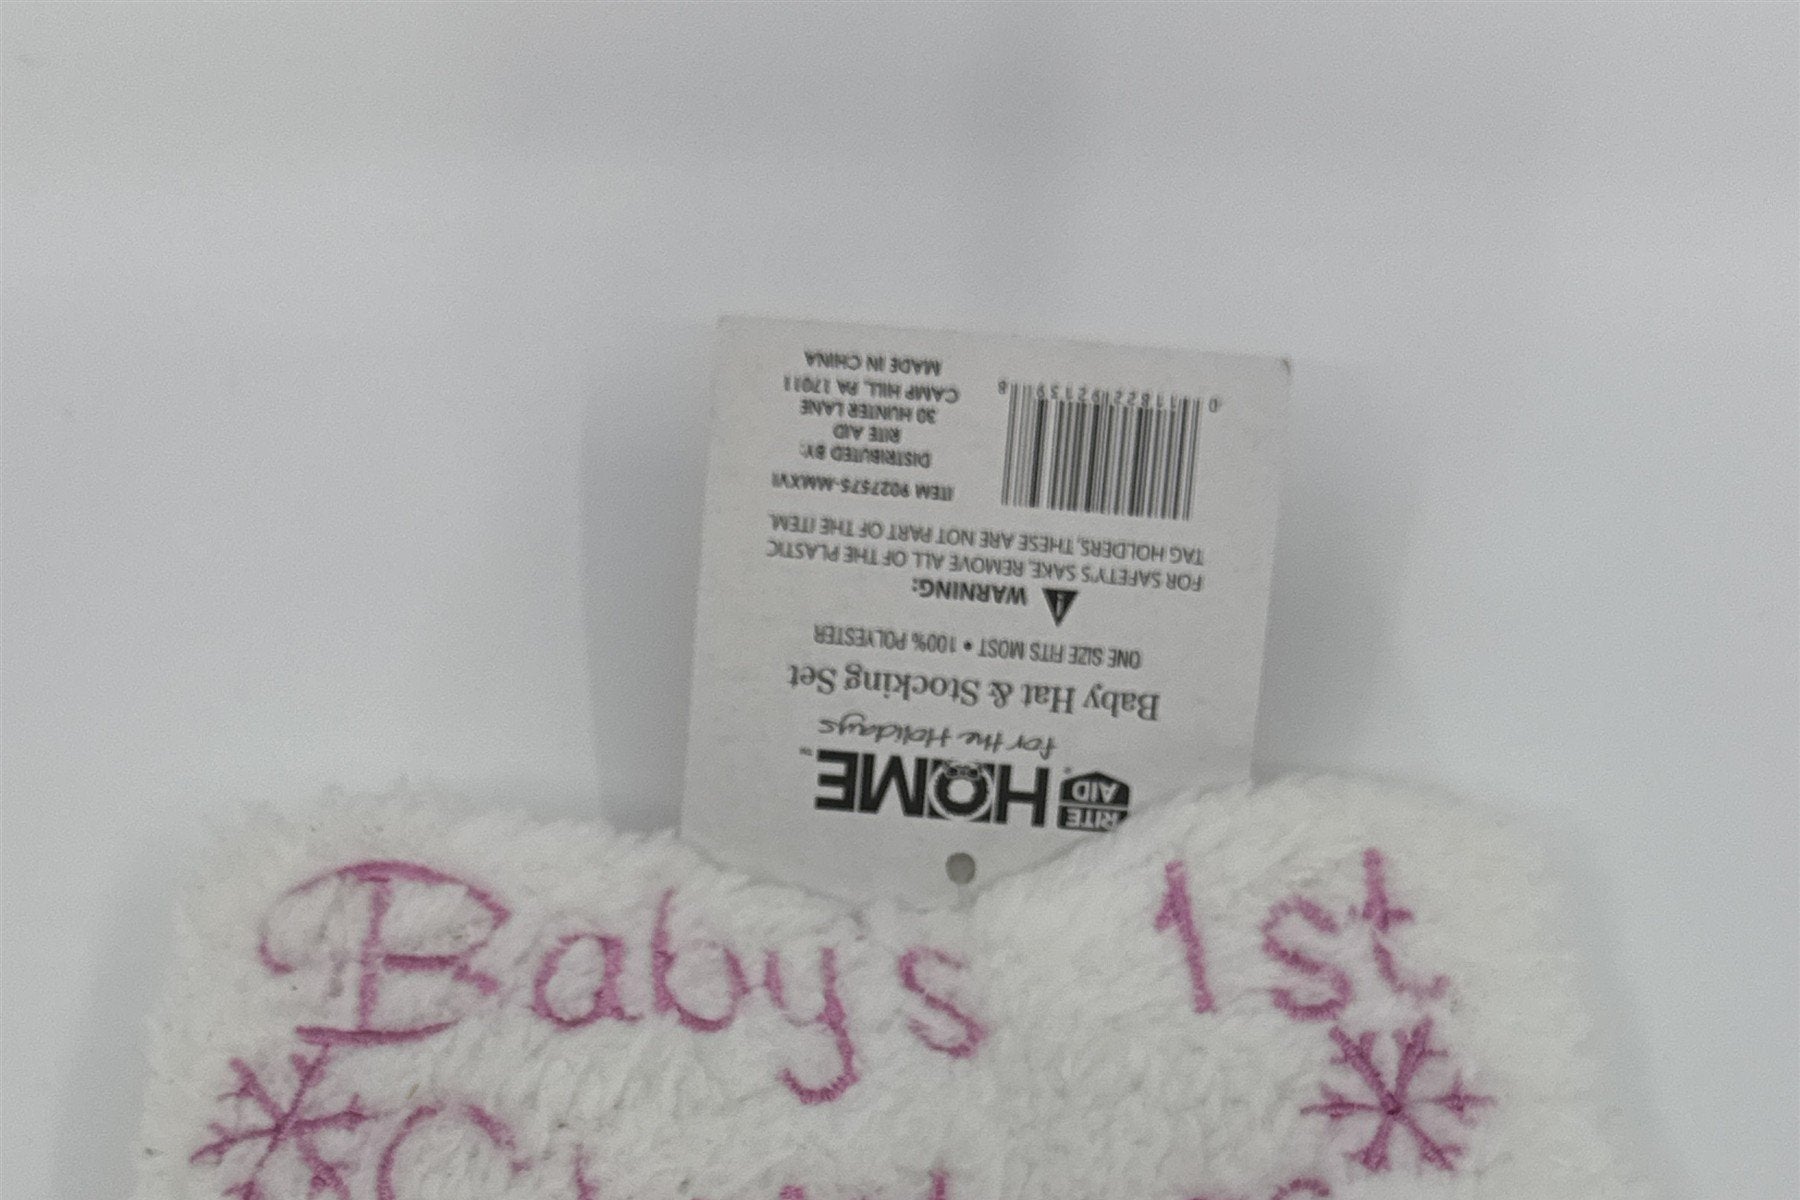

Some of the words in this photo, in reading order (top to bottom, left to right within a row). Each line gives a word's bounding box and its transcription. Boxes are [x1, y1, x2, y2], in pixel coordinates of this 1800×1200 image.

[803, 349, 862, 370] CHINA
[865, 354, 886, 371] IN
[889, 356, 942, 376] MADE
[783, 374, 829, 394] 17011
[836, 379, 858, 396] PA
[904, 384, 960, 404] CAMP
[799, 398, 844, 416] LANE
[847, 401, 912, 422] HUNTER
[916, 406, 936, 424] 30
[832, 423, 863, 439] AID
[870, 426, 900, 443] RITE
[829, 443, 932, 469] DISTRIBUTED
[914, 483, 955, 501] ITEM
[819, 515, 854, 537] THE
[858, 520, 885, 539] OF
[886, 523, 933, 543] PART
[935, 527, 976, 546] NOT
[765, 537, 840, 562] PLASTIC
[979, 530, 1014, 549] ARE
[1018, 532, 1073, 555] THESE
[1076, 536, 1166, 561] HOLDERS,
[843, 545, 878, 565] THE
[881, 549, 908, 568] OF
[911, 550, 944, 569] ALL
[949, 554, 1023, 577] REMOVE
[1169, 545, 1204, 566] TAG
[1081, 565, 1161, 589] SAFETY'S
[1165, 572, 1204, 592] FOR
[911, 577, 1028, 606] WARNING:
[812, 623, 908, 650] POLYESTER
[911, 631, 956, 653] 100%
[977, 637, 1025, 660] MOST
[1029, 641, 1065, 663] FITS
[1067, 644, 1103, 666] SIZE
[1107, 648, 1142, 669] ONE
[787, 664, 837, 695] Set
[843, 662, 981, 706] Stocking
[988, 680, 1014, 708] &
[1020, 683, 1075, 714] Hat
[1082, 683, 1160, 721] Baby
[817, 711, 951, 747] Holidays
[957, 730, 1003, 753] the
[1005, 734, 1056, 760] for
[816, 749, 1050, 828] HOME
[1070, 780, 1120, 803] AID
[1065, 807, 1119, 832] RITE
[1154, 848, 1450, 1020] 1st
